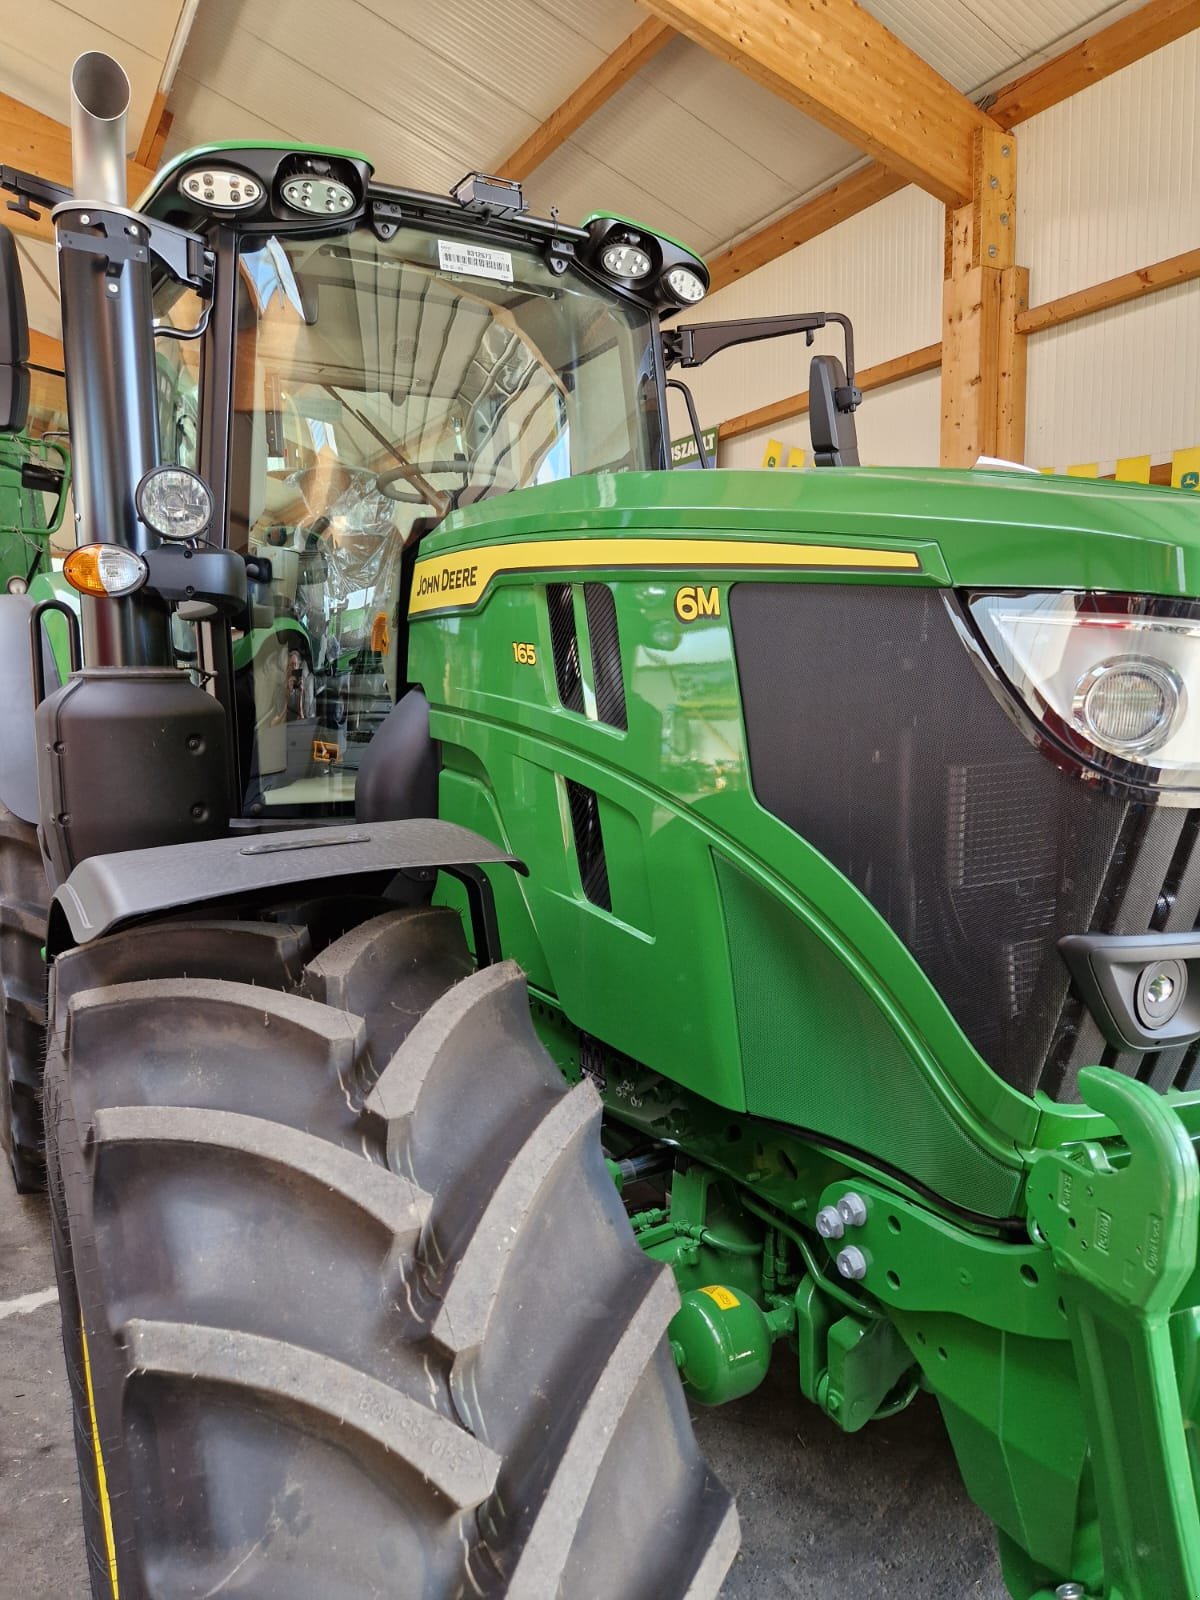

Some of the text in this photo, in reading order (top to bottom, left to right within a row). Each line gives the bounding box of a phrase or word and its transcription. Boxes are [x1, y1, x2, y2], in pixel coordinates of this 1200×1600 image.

[416, 566, 478, 596] JOHN DEERE
[674, 585, 721, 624] 6M
[512, 641, 537, 665] 165
